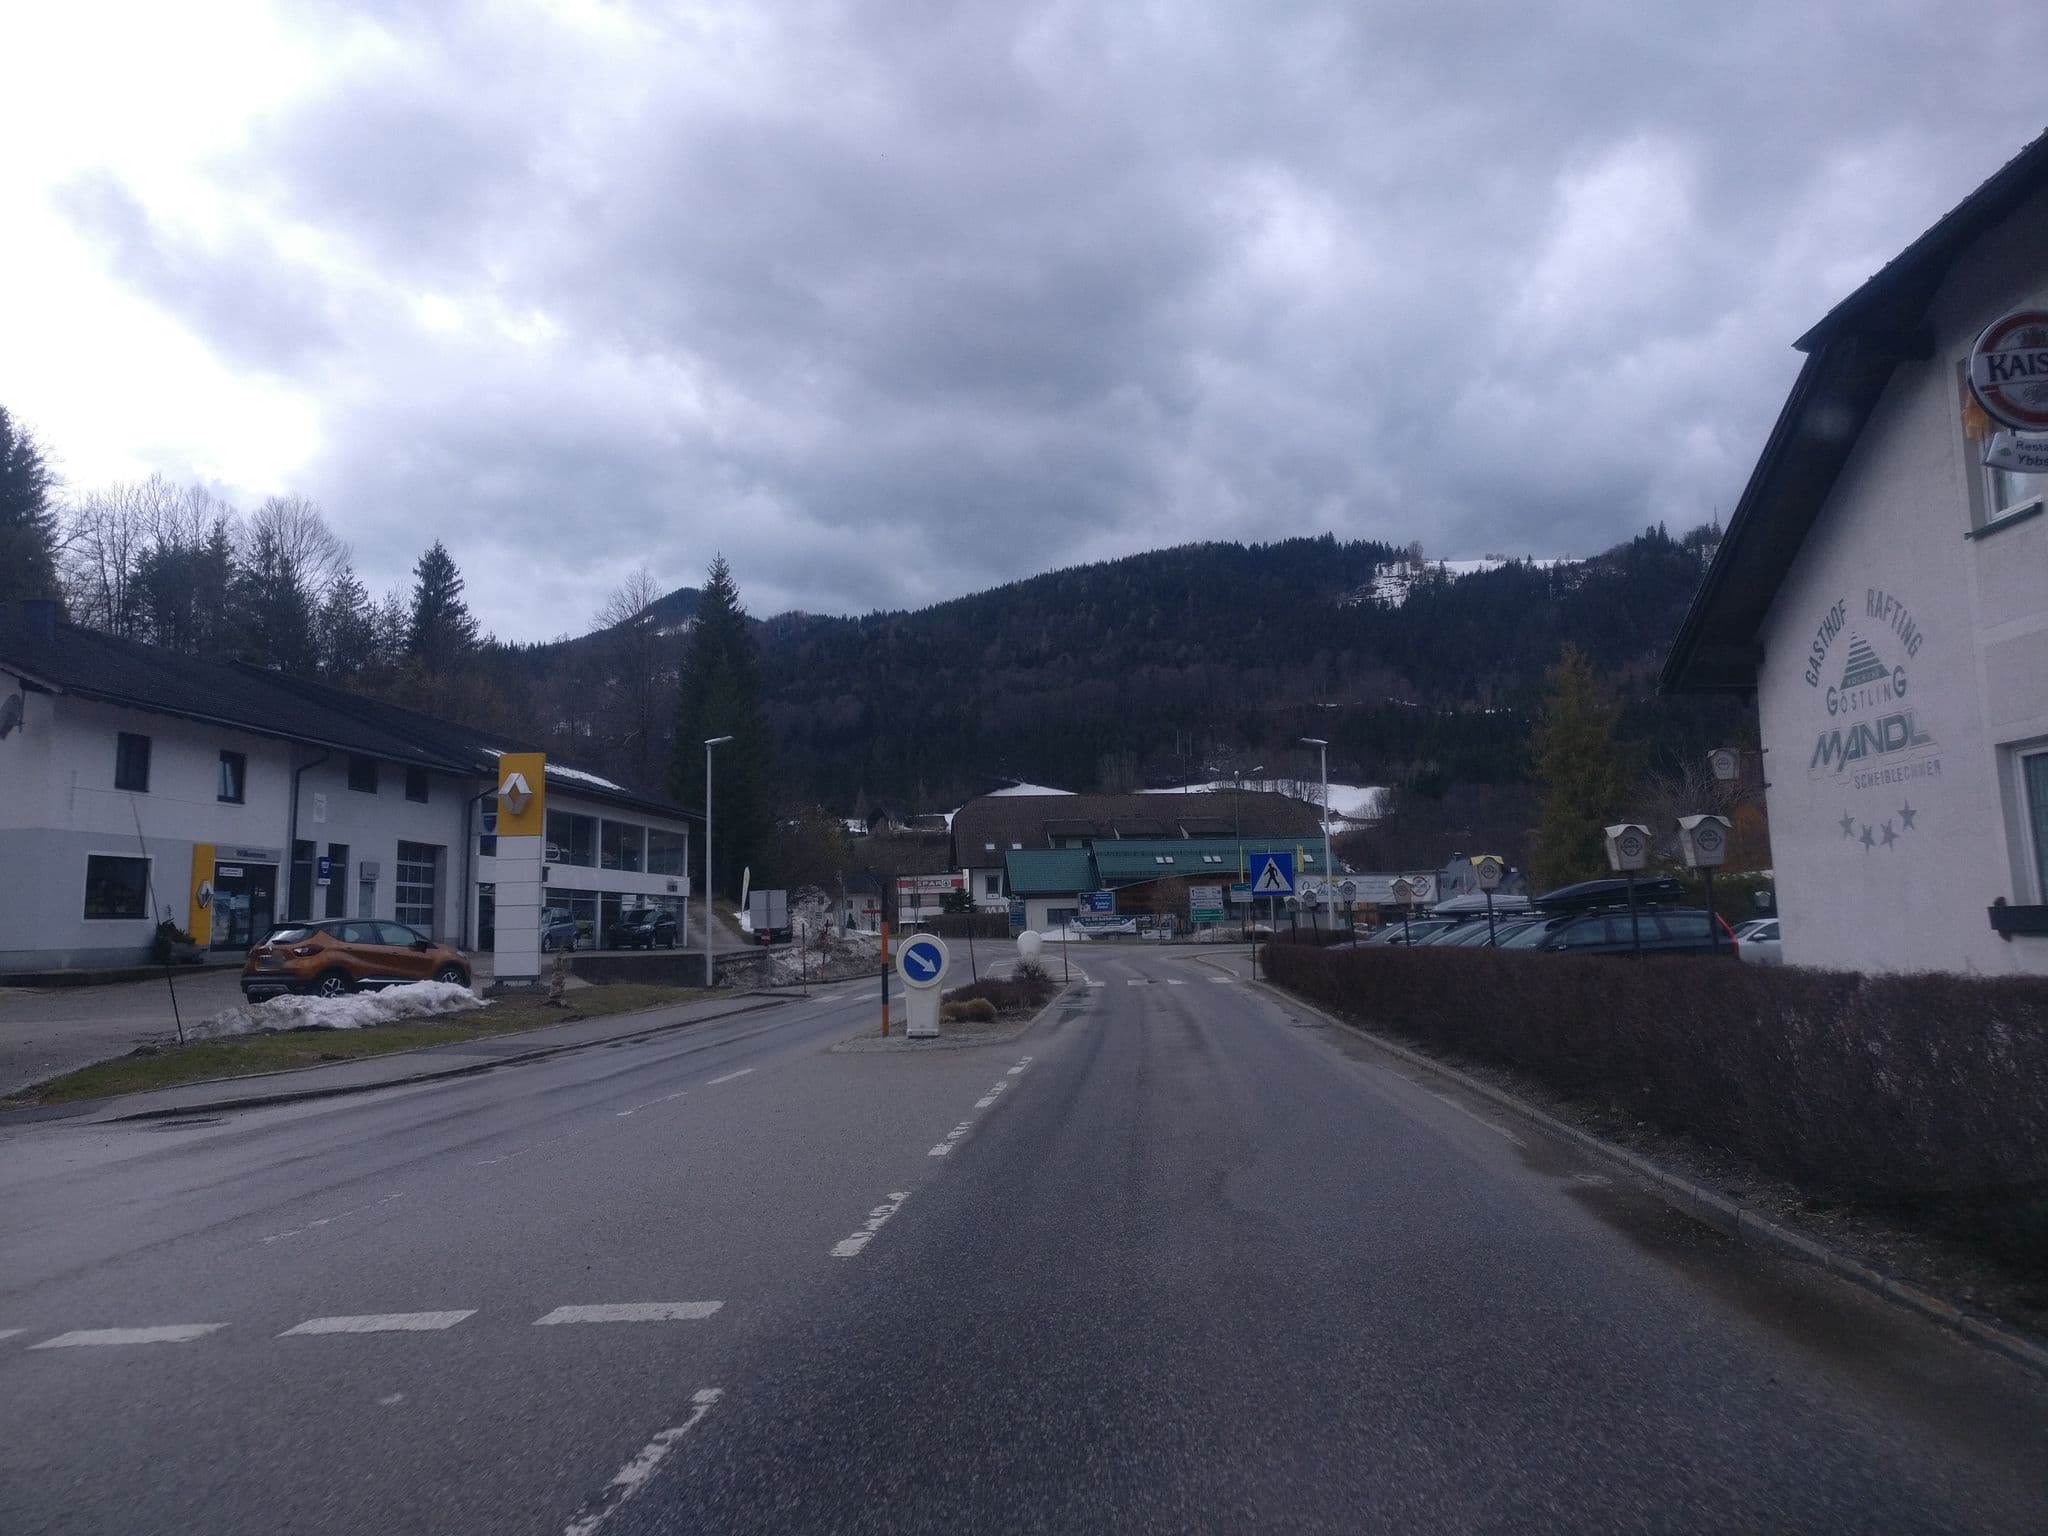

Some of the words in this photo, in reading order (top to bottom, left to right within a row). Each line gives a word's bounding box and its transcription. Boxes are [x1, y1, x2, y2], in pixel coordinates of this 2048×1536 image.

[1805, 598, 1846, 688] GASTHOF
[1866, 588, 1923, 659] RAFTING
[1809, 709, 1933, 773] MANDL
